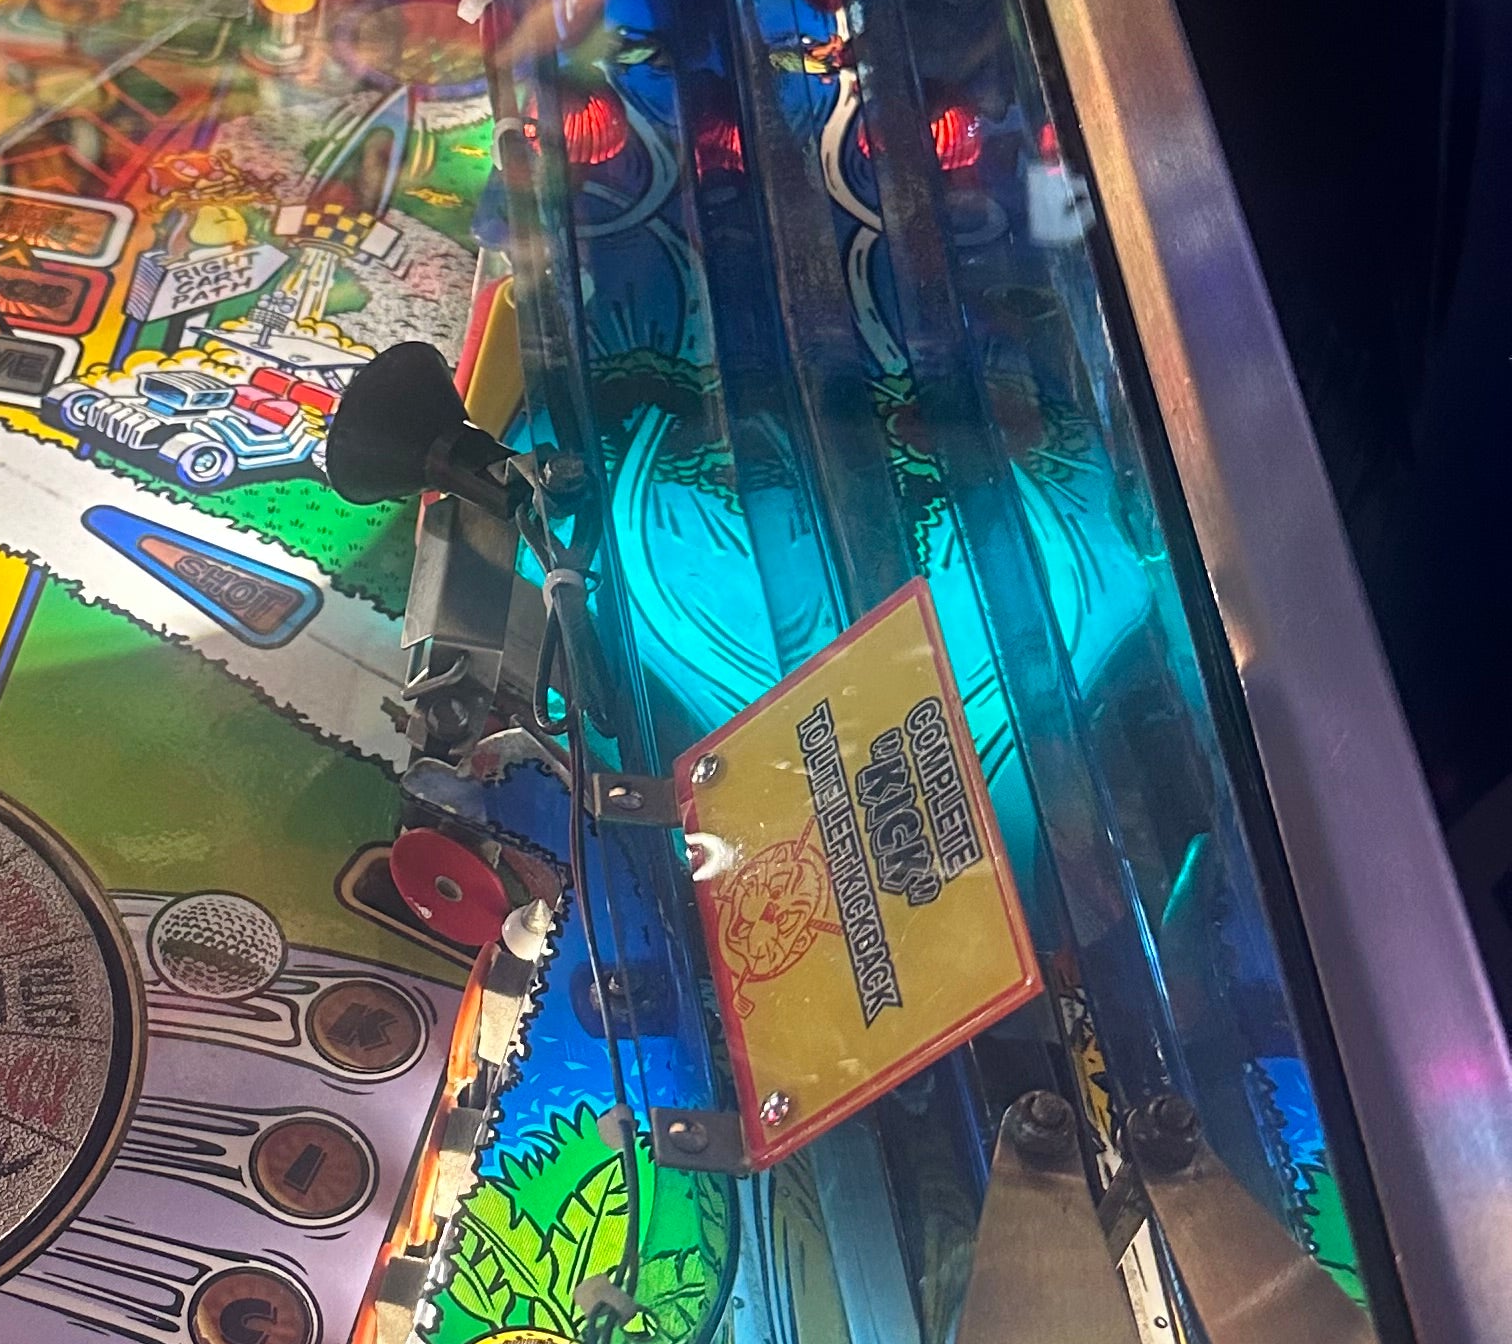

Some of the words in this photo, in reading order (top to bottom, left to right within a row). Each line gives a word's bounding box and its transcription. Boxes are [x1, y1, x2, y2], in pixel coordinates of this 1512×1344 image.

[171, 251, 259, 286] RIGHT
[171, 276, 255, 308] PATH
[174, 262, 255, 296] CART
[172, 554, 278, 634] SHOT
[796, 698, 837, 753] TO
[805, 738, 852, 812] LITE
[905, 696, 984, 882] COMPLETE
[820, 798, 864, 867] LEFT
[831, 856, 904, 1029] KICKBACK
[326, 1000, 401, 1054] K
